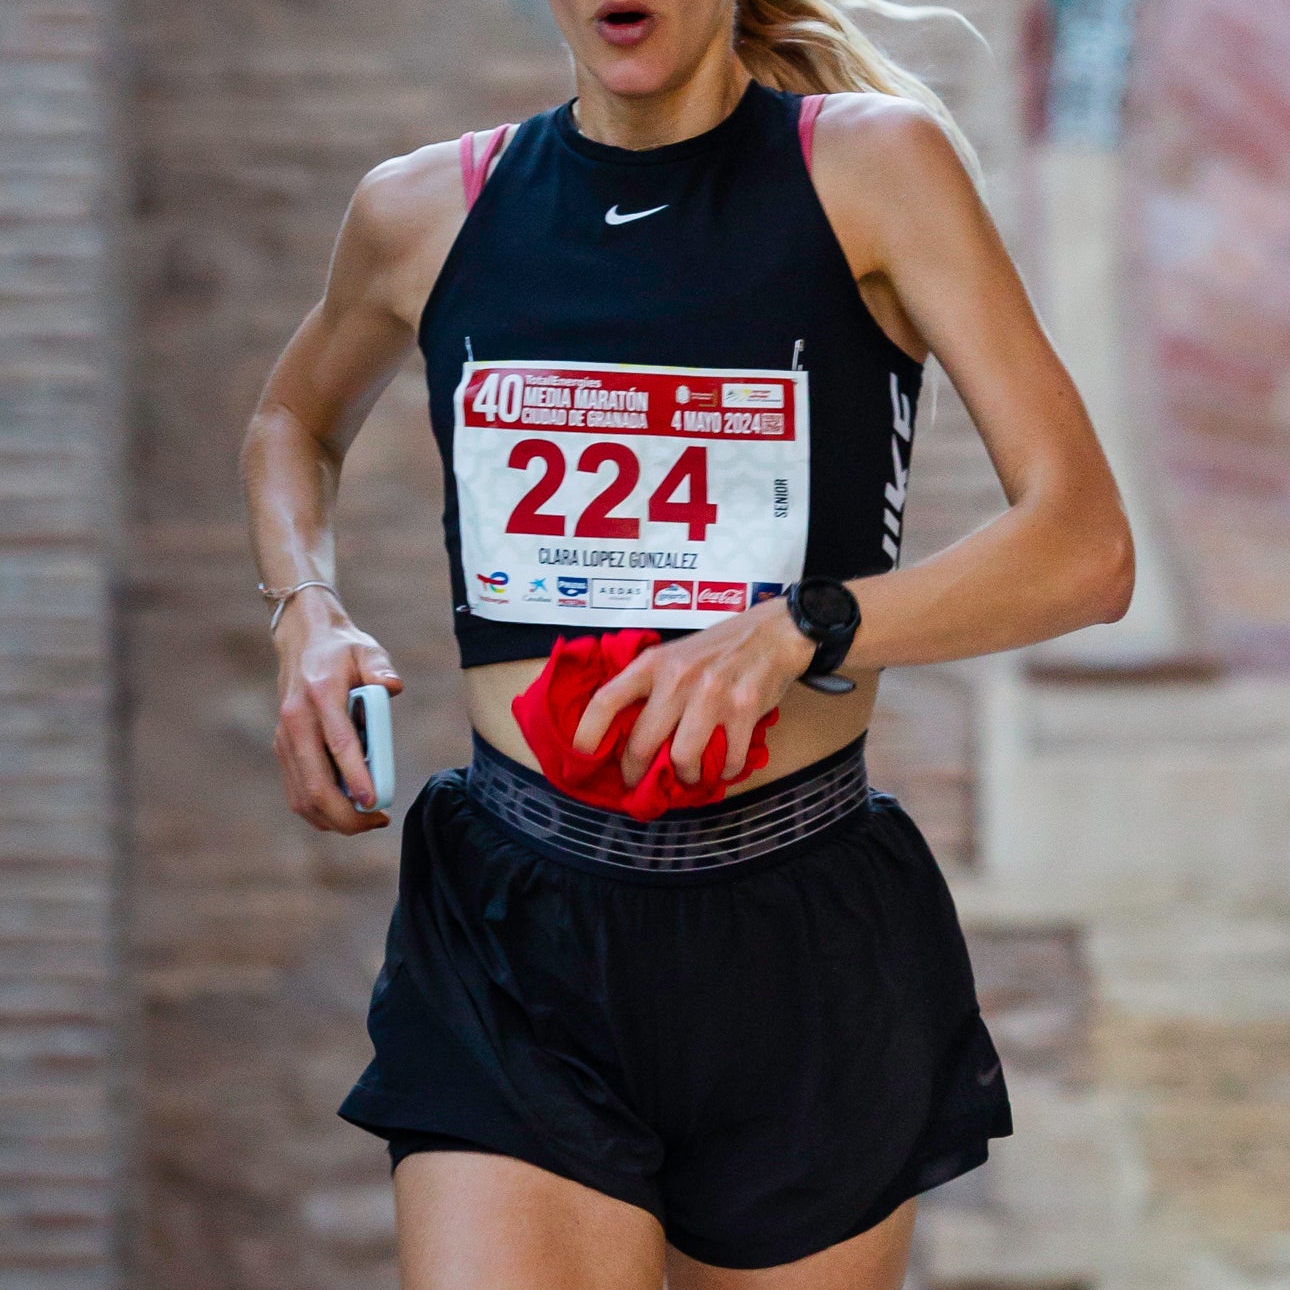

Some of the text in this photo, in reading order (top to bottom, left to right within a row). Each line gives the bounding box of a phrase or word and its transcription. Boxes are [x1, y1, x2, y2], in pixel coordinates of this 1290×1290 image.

[472, 373, 524, 423] 40
[523, 386, 649, 411] MEDIA MARATÓN
[521, 407, 648, 428] CIUDAD DE GRANADA
[671, 410, 762, 434] 4 MAYO 2024
[505, 438, 717, 541] 224
[774, 478, 788, 518] SENIOR
[538, 548, 698, 569] CLARA LOPEZ GONZALEZ
[599, 587, 641, 596] AEDAS
[596, 801, 780, 872] NIKE
